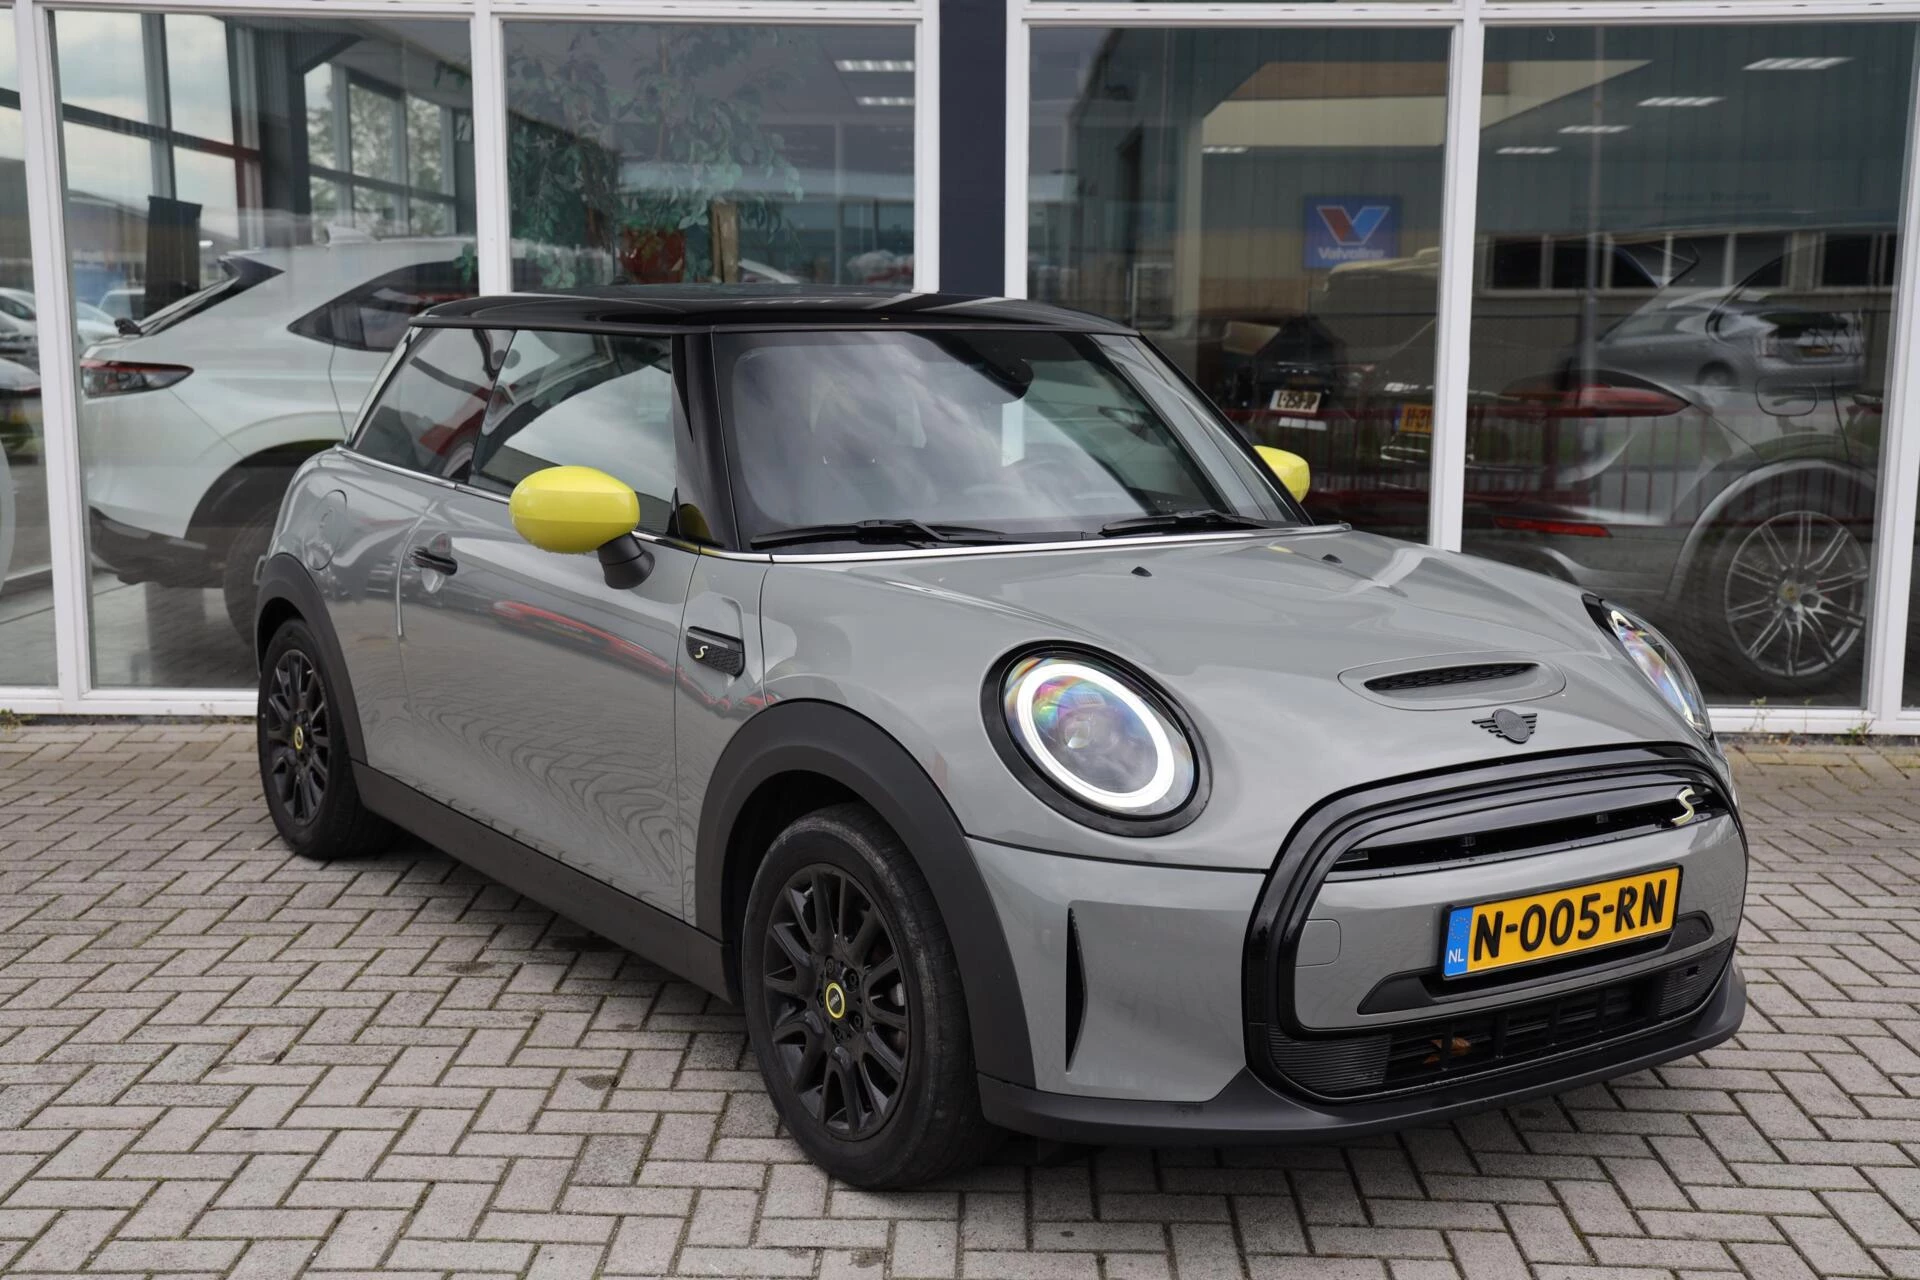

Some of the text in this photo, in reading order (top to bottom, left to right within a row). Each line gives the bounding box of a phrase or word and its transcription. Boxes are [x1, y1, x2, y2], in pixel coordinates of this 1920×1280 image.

[694, 645, 708, 659] S
[1671, 787, 1696, 826] S
[1473, 879, 1667, 962] N-005-RN
[1448, 948, 1465, 965] NL
